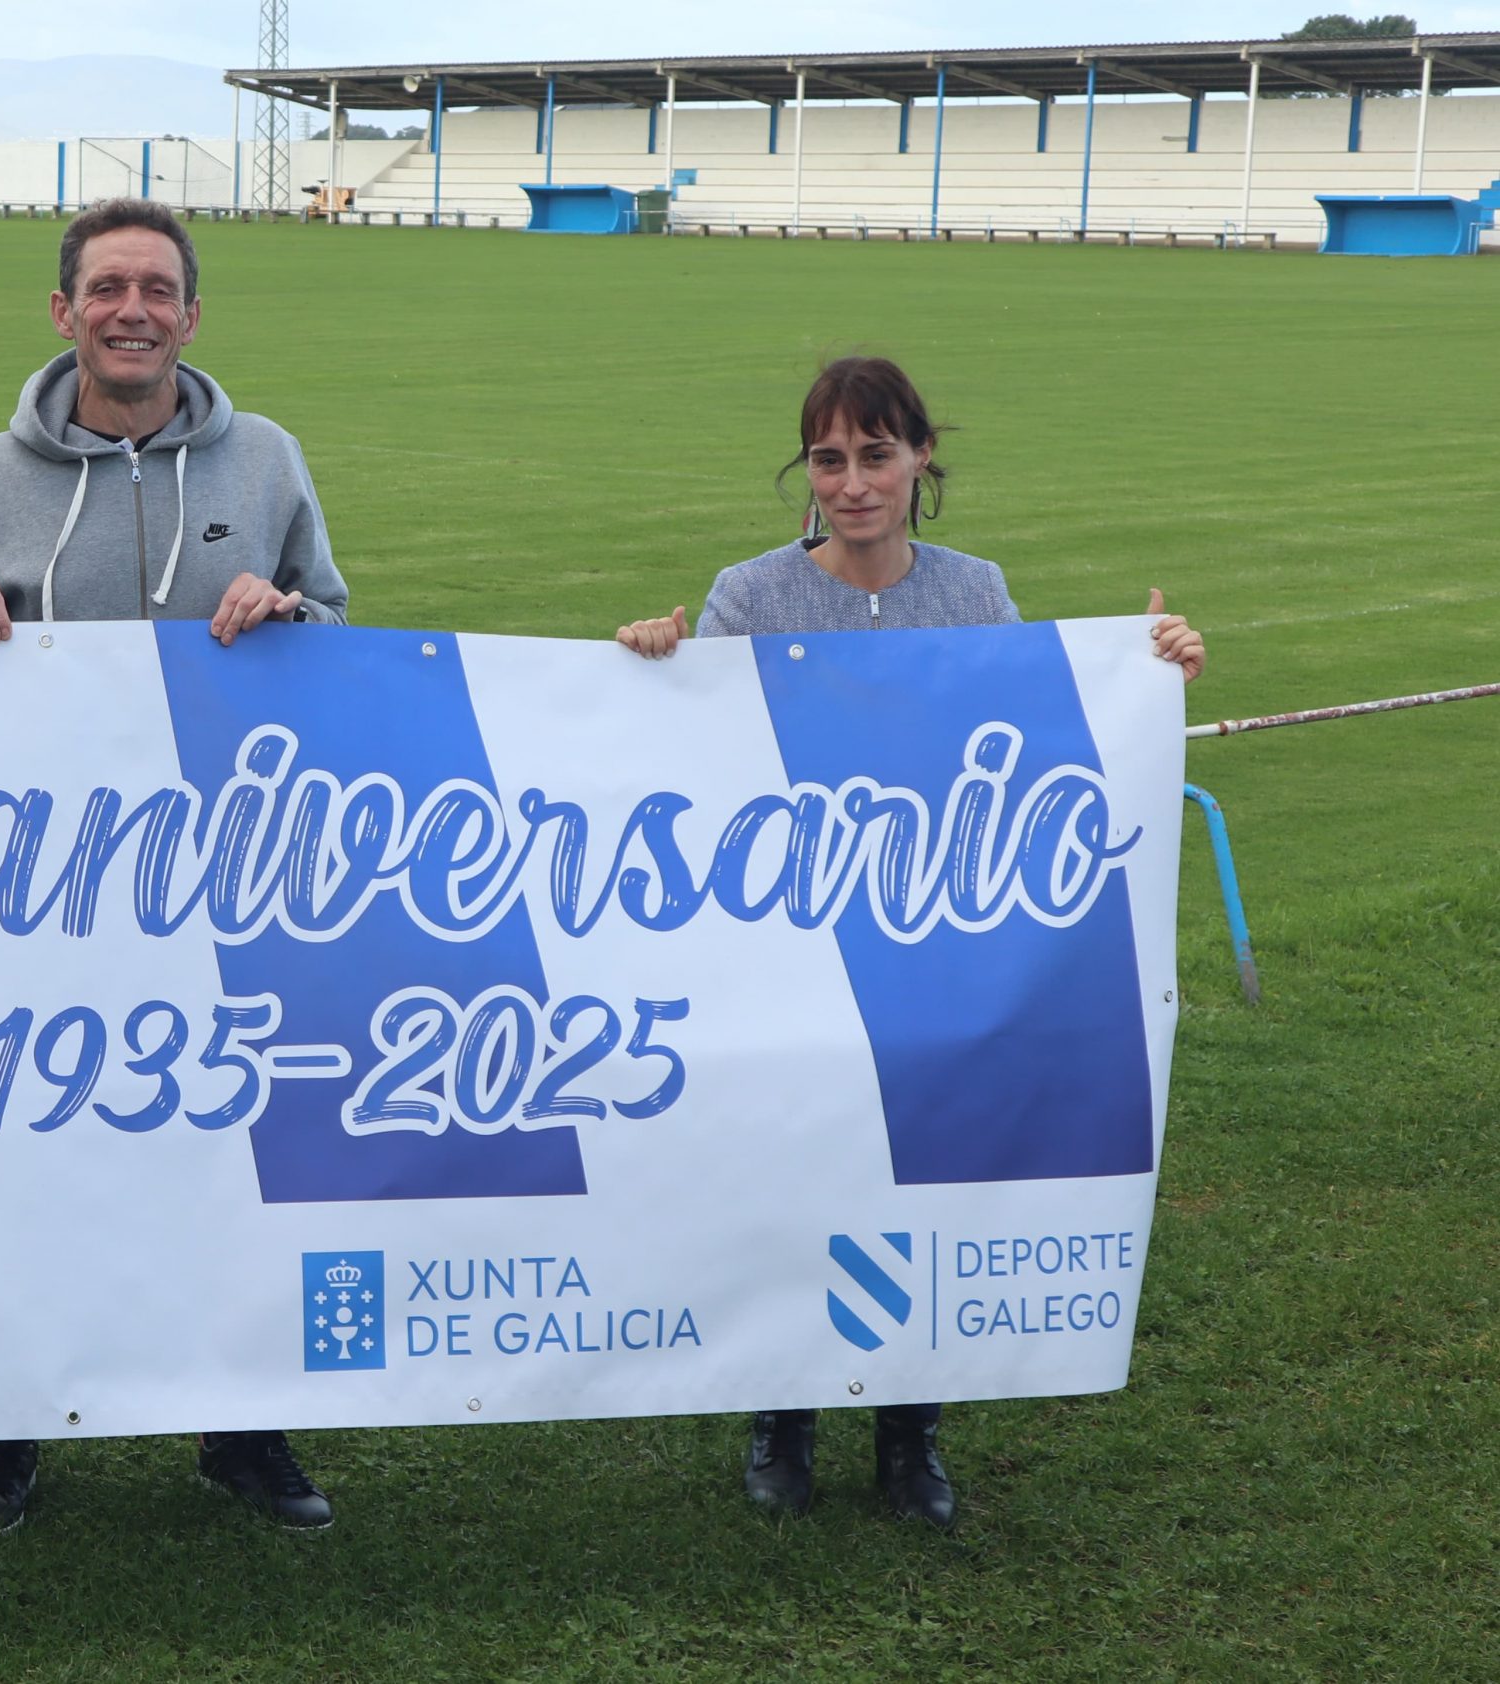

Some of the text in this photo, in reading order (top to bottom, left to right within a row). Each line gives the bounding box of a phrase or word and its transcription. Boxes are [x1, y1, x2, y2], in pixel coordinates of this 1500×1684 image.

[207, 522, 231, 536] NIKE
[406, 1256, 592, 1302] XUNTA
[956, 1231, 1134, 1279] DEPORTE
[406, 1307, 703, 1357] DE GALICIA
[956, 1290, 1121, 1338] GALEGO
